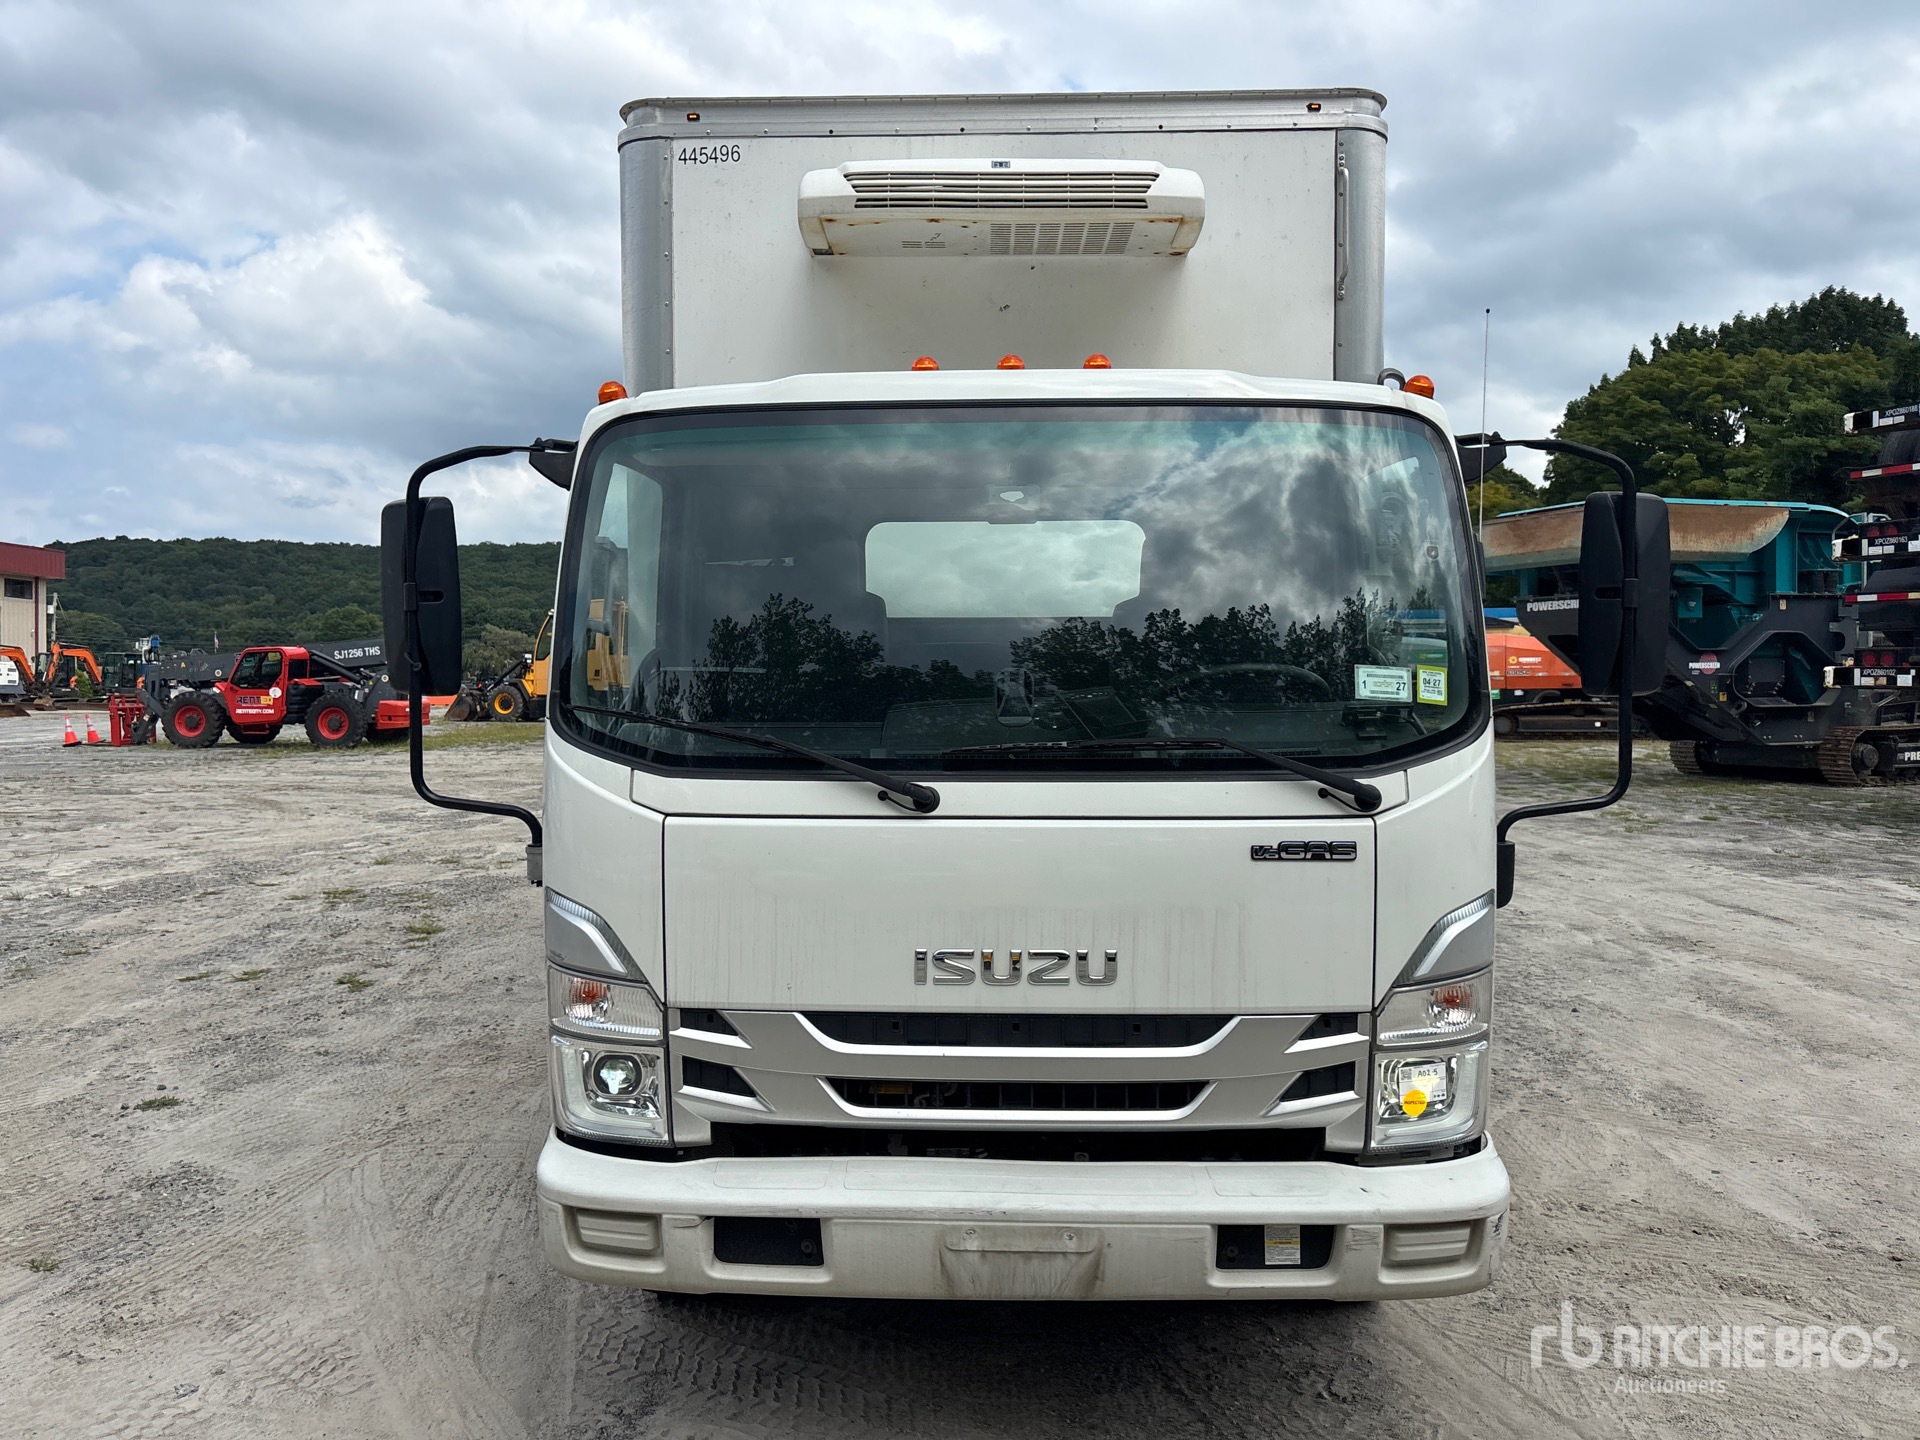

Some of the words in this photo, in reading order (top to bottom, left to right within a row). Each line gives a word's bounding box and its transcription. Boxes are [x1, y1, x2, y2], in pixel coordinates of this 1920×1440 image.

[678, 144, 741, 165] 445496
[334, 648, 364, 660] SJ1256
[364, 646, 381, 656] THS
[1362, 680, 1366, 689] 1
[1396, 682, 1406, 691] 27
[914, 948, 1118, 986] ISUZU
